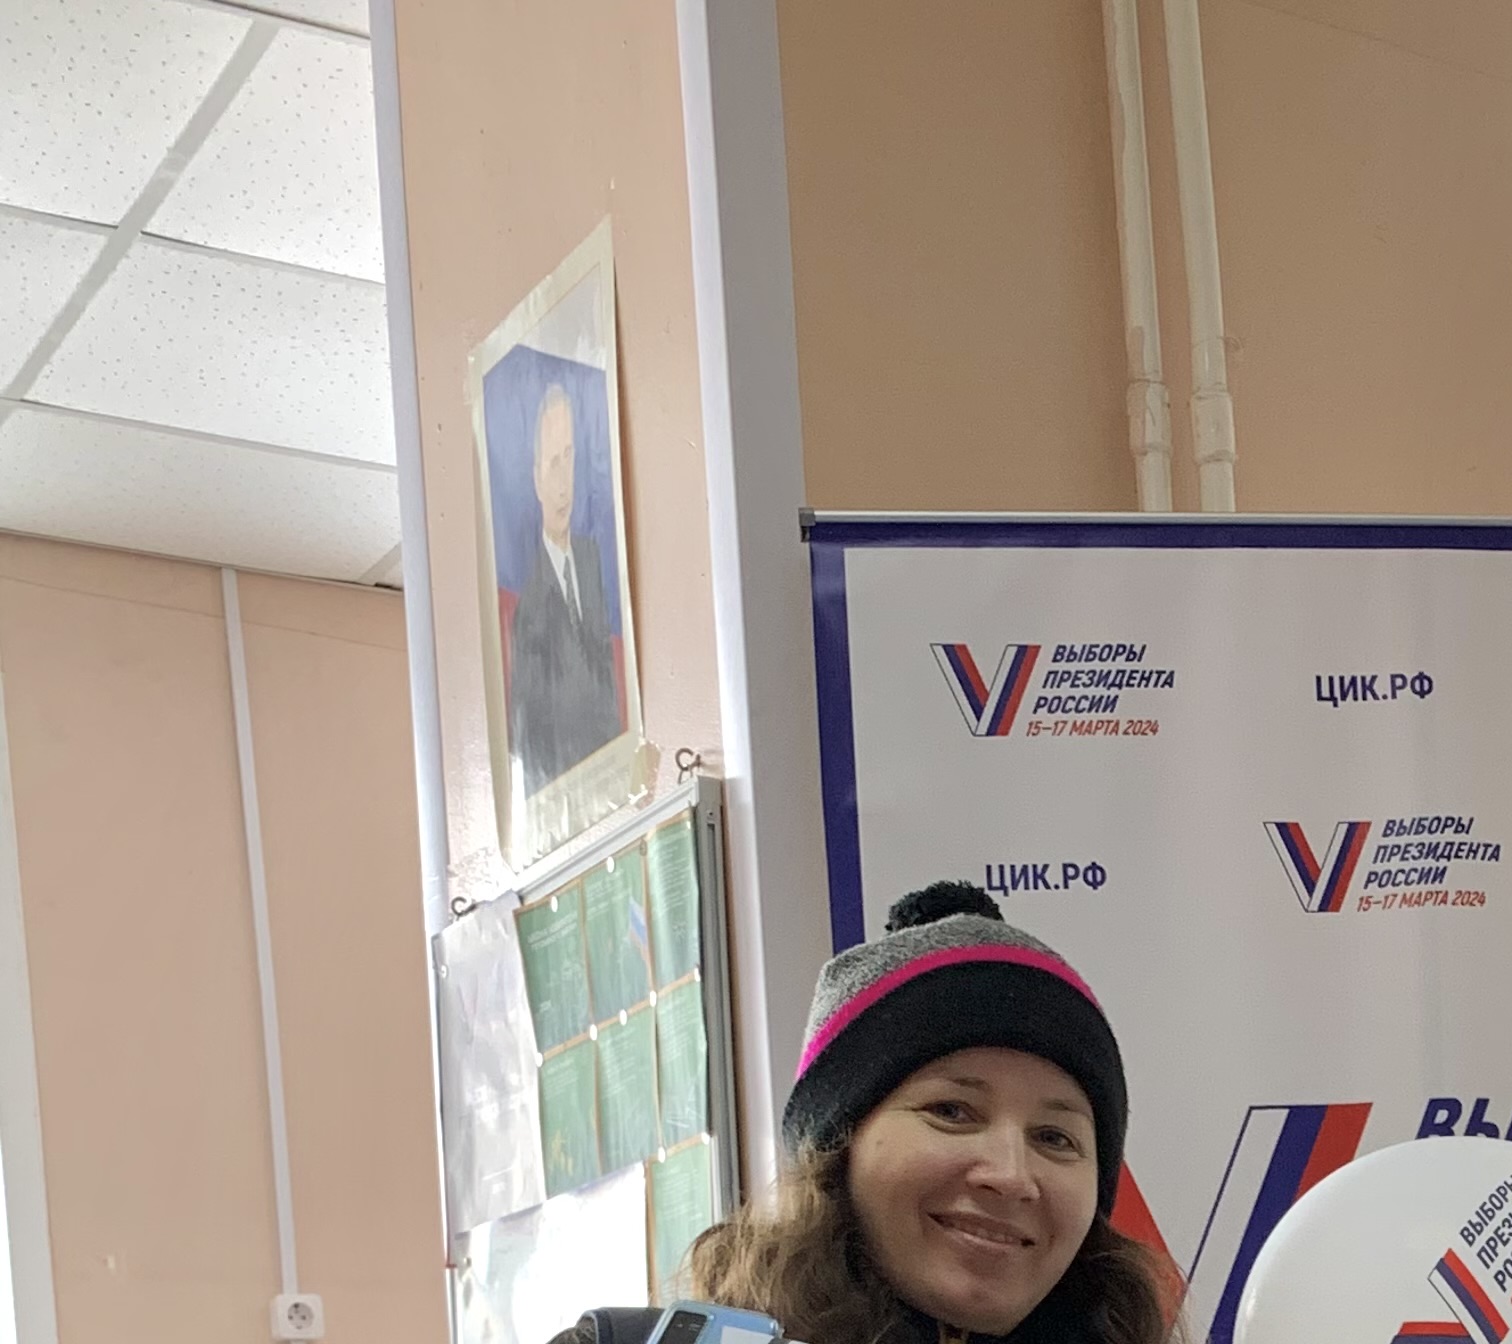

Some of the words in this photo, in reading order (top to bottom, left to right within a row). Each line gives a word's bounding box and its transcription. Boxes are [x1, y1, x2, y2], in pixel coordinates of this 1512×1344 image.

[1051, 643, 1147, 663] ВЫБОРЫ
[1042, 669, 1175, 690] ПРЕЗИДЕНТА
[1315, 671, 1434, 708] ЦИК.РФ
[1032, 695, 1119, 714] РОССИИ
[1069, 719, 1121, 737] МАРТА
[1122, 719, 1160, 736] 2024
[1381, 816, 1475, 838] ВЫБОРЫ
[1372, 841, 1501, 865] ПРЕЗИДЕНТА
[985, 861, 1107, 897] ЦИК.РФ
[1363, 866, 1448, 890] РОССИИ
[1398, 890, 1451, 909] МАРТА
[1451, 890, 1486, 908] 2024
